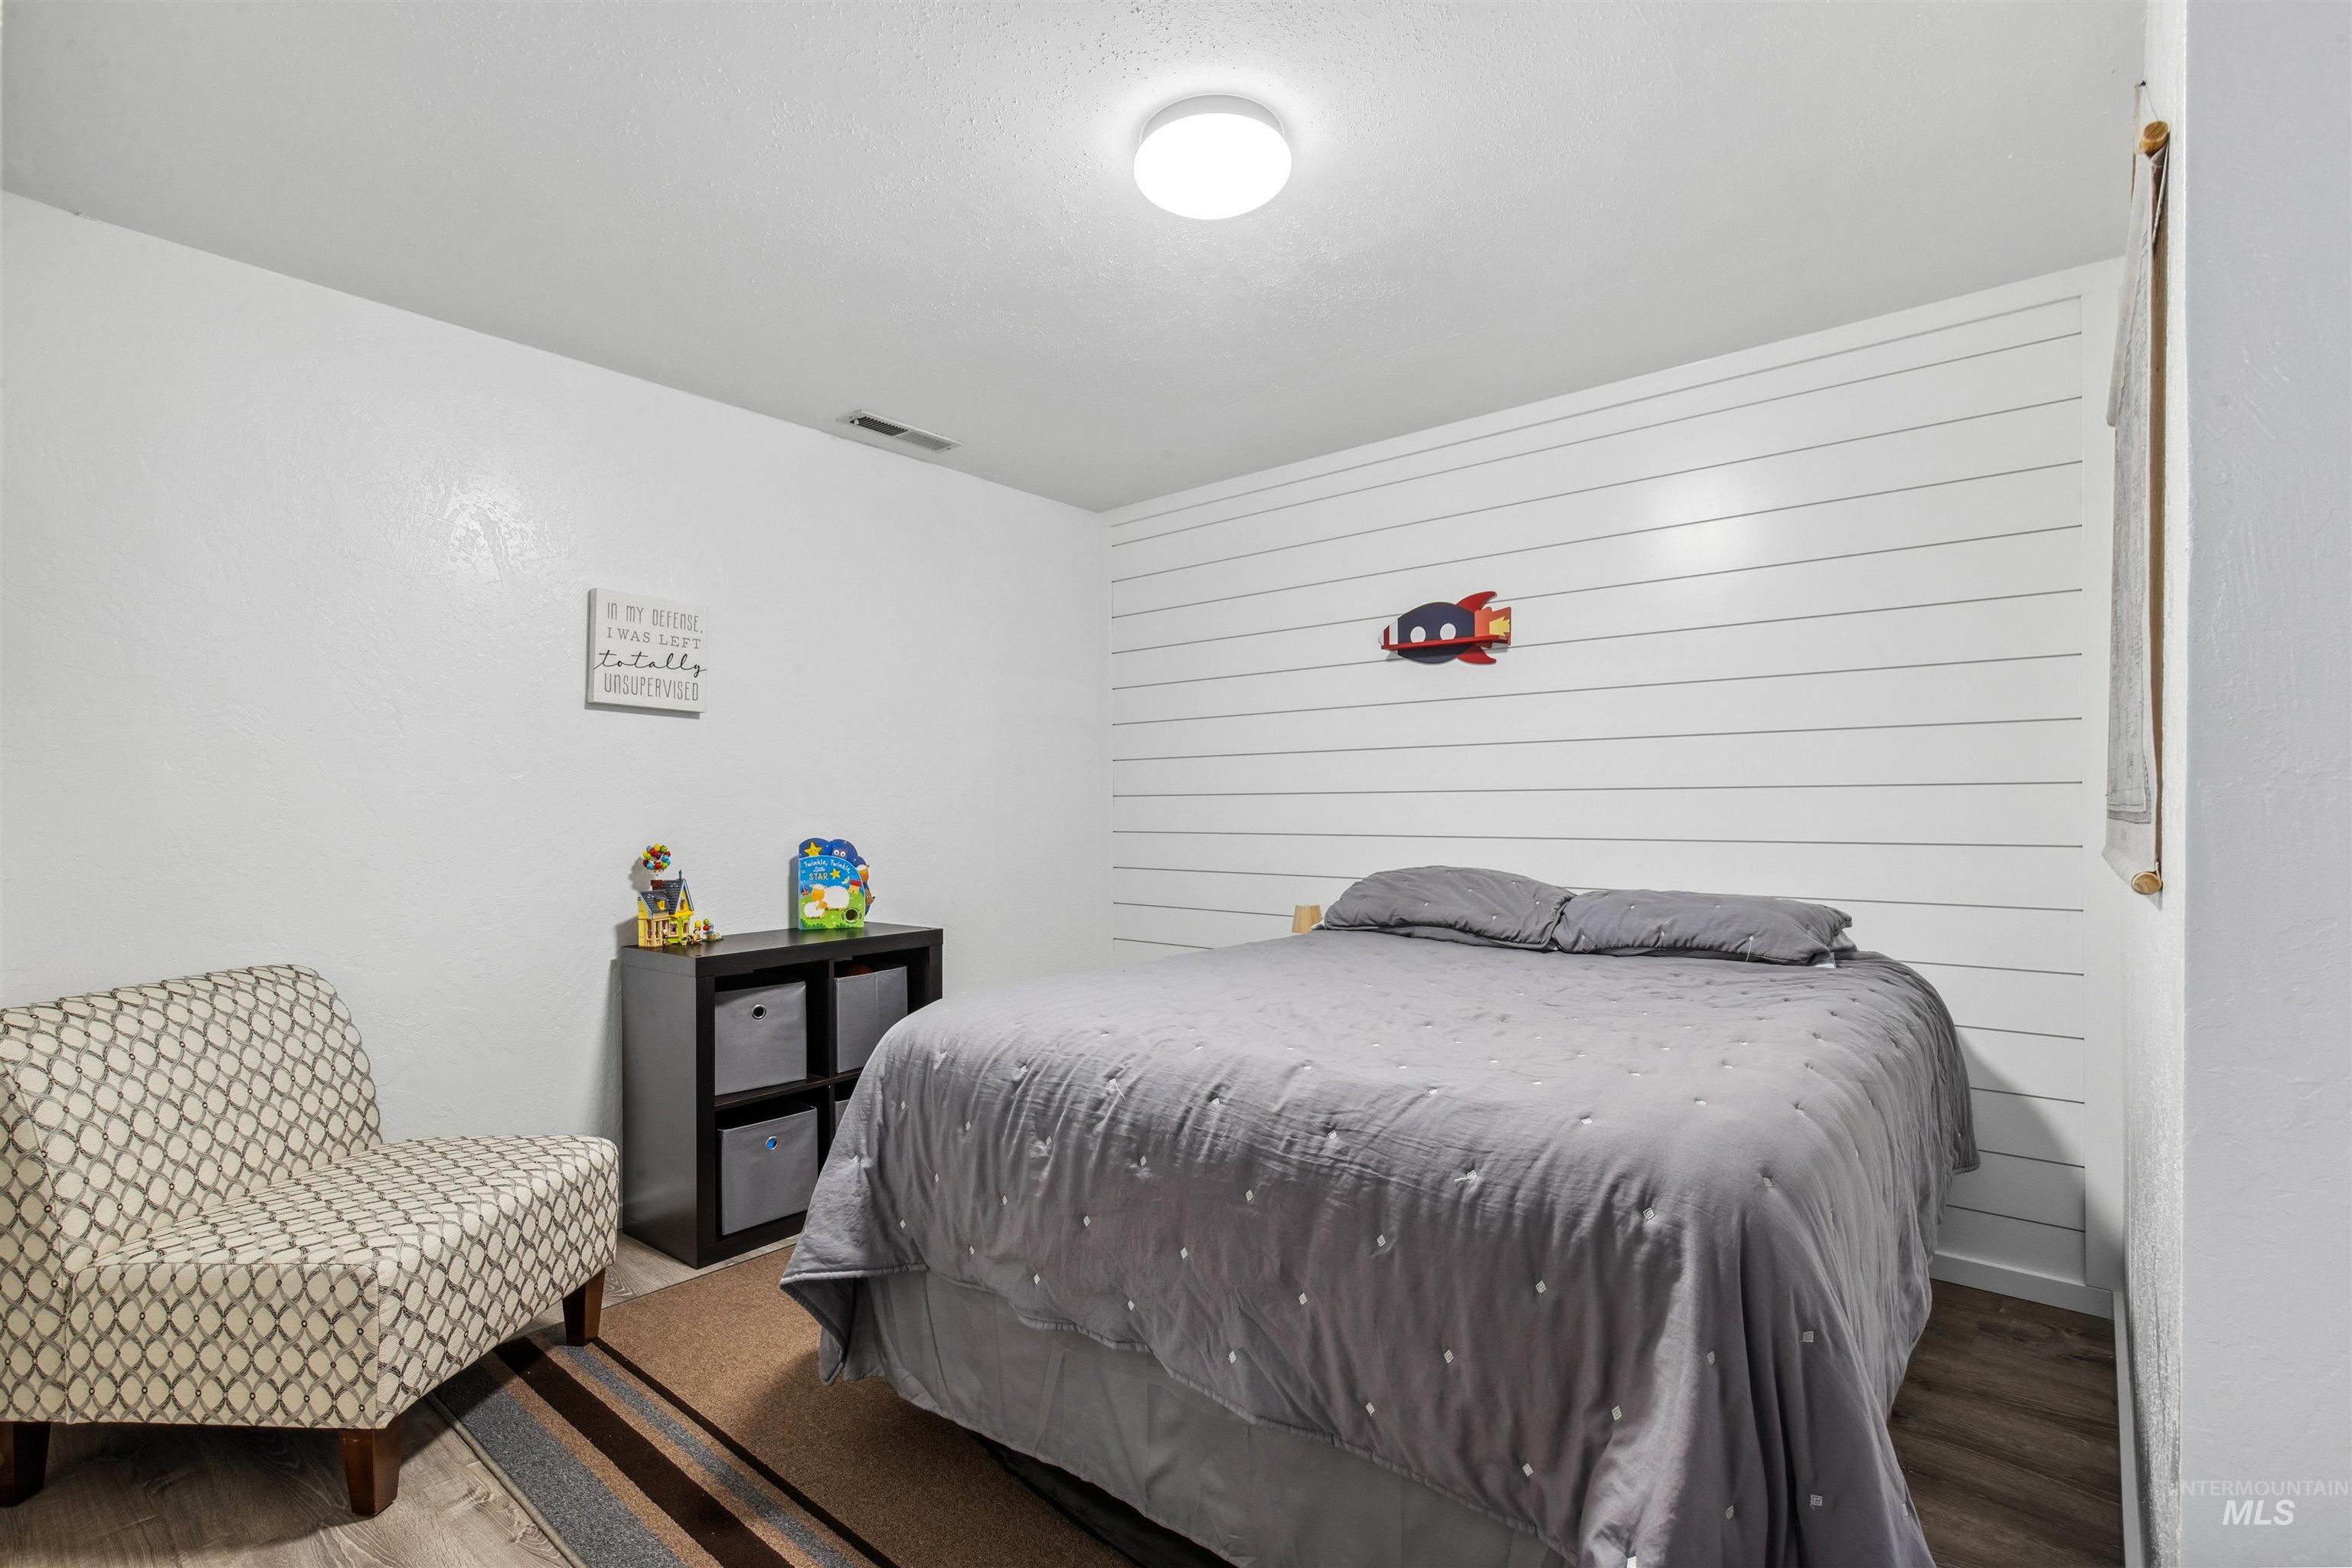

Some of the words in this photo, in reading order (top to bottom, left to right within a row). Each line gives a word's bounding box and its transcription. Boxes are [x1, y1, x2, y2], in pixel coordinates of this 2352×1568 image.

[607, 627, 612, 639] I
[617, 628, 651, 643] WAS
[658, 634, 701, 649] LEFT
[593, 649, 707, 678] totally
